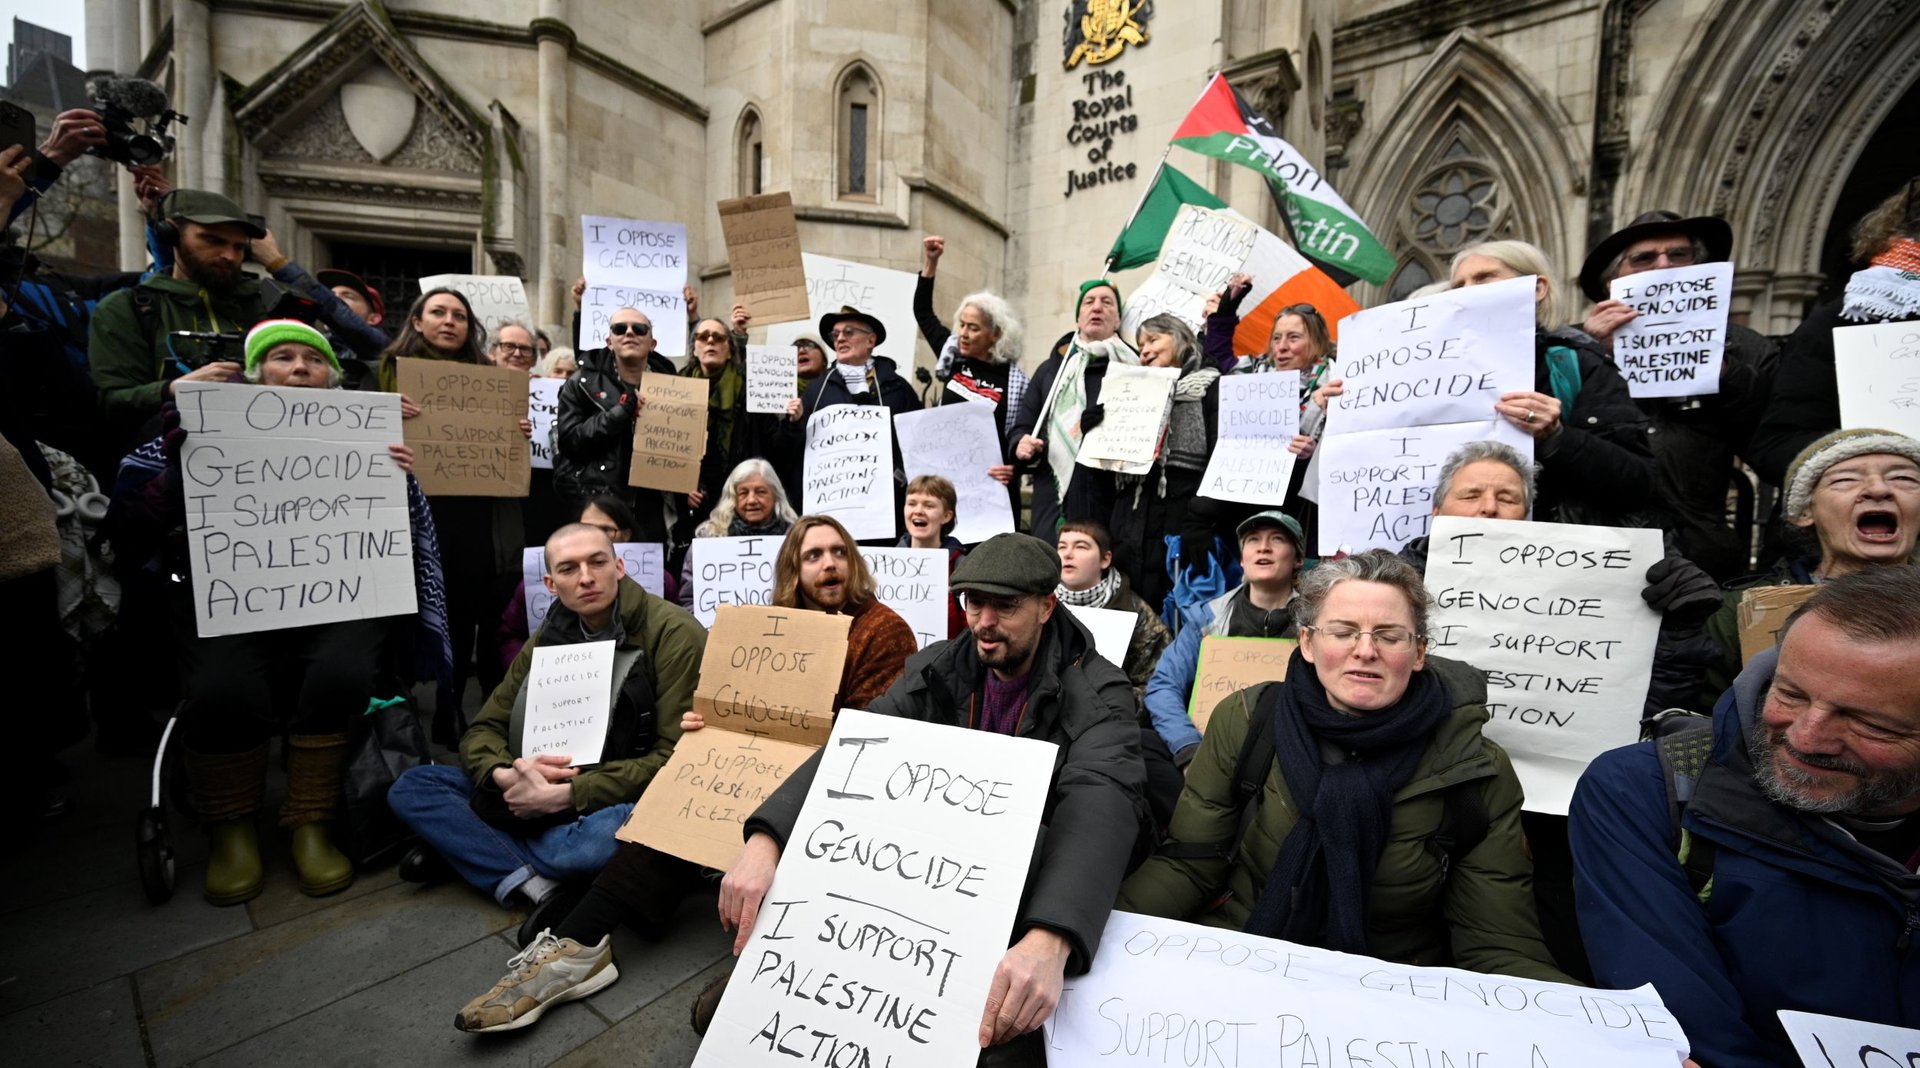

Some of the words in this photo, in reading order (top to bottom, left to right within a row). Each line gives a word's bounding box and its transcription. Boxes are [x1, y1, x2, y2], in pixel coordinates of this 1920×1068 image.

[1082, 69, 1124, 95] The
[1072, 84, 1132, 121] Royal
[1067, 114, 1138, 144] Courts
[1088, 138, 1112, 163] of
[1064, 161, 1136, 197] Justice
[589, 225, 606, 243] I
[618, 229, 676, 248] OPPOSE
[599, 248, 680, 269] GENOCIDE
[835, 264, 858, 284] I
[465, 281, 524, 307] PPOSE
[590, 287, 607, 306] I
[615, 290, 680, 310] SUPPORT
[1622, 288, 1633, 299] I
[1645, 276, 1716, 297] OPPOSE
[1631, 295, 1717, 316] ENOCIDE
[1401, 304, 1428, 333] I
[1619, 335, 1628, 348] I
[1632, 328, 1716, 349] SUPPORT
[749, 352, 760, 364] I
[761, 355, 796, 366] OPPOSE
[1345, 338, 1460, 379] OPPOSE
[1624, 349, 1711, 368] PALESTINE
[420, 373, 424, 389] I
[437, 375, 510, 393] OPPOSE
[752, 366, 794, 377] GENOCIDE
[1628, 366, 1696, 384] ACTION
[748, 379, 754, 388] I
[1122, 382, 1131, 393] I
[1221, 385, 1228, 401] I
[1236, 381, 1297, 401] OPPOSE
[1339, 371, 1496, 410] GENOCIDE
[180, 389, 221, 433] I
[246, 390, 388, 430] OPPOSE
[422, 392, 525, 416] GENOCIDE
[1221, 408, 1294, 432] GENOCIDE
[441, 425, 518, 441] SUPPORT
[642, 424, 690, 440] SUPPORT
[423, 444, 519, 460] PALESTINE
[1390, 437, 1421, 457] I
[186, 445, 392, 487] GENOCIDE
[434, 464, 506, 480] ACTION
[647, 456, 687, 469] ACTION
[813, 455, 878, 475] SUPPORT
[1213, 456, 1291, 474] PALESTINE
[1330, 464, 1436, 484] SUPPORT
[817, 480, 873, 504] ACTION
[1212, 475, 1280, 494] ACTION
[1354, 486, 1437, 512] PALES
[189, 495, 217, 531] I
[234, 494, 386, 527] SUPPORT
[1369, 512, 1433, 541] ACT
[203, 529, 408, 573] PALESTINE
[738, 539, 762, 556] I
[1450, 533, 1484, 564] I
[1499, 544, 1632, 569] OPPOSE
[702, 561, 772, 582] OPPO
[208, 576, 361, 618] ACTION
[699, 588, 771, 612] GENOC
[1438, 587, 1605, 618] GENOCIDE
[763, 615, 787, 636] I
[1438, 625, 1467, 646] I
[1490, 633, 1622, 660] SUPPORT
[555, 652, 592, 664] OPPOSE
[731, 646, 816, 674] OPPOSE
[1208, 649, 1222, 664] I
[1233, 650, 1285, 666] OPPOS
[538, 670, 600, 687] GENOCIDE
[1484, 669, 1603, 694] ESTINE
[552, 696, 591, 709] SUPPORT
[533, 716, 593, 733] PALESTINE
[1481, 703, 1575, 727] TION
[532, 740, 567, 753] ACTION
[738, 729, 769, 750] I
[827, 737, 889, 800] I
[885, 761, 1013, 815] OPPOSE
[804, 820, 986, 897] GENOCIDE
[760, 901, 808, 939] I
[817, 914, 962, 997] SUPPORT
[751, 950, 937, 1044] PALESTINE
[1124, 930, 1310, 981] OPPOSE
[1361, 970, 1674, 1042] GENOCIDE
[1099, 997, 1256, 1068] SUPPORT
